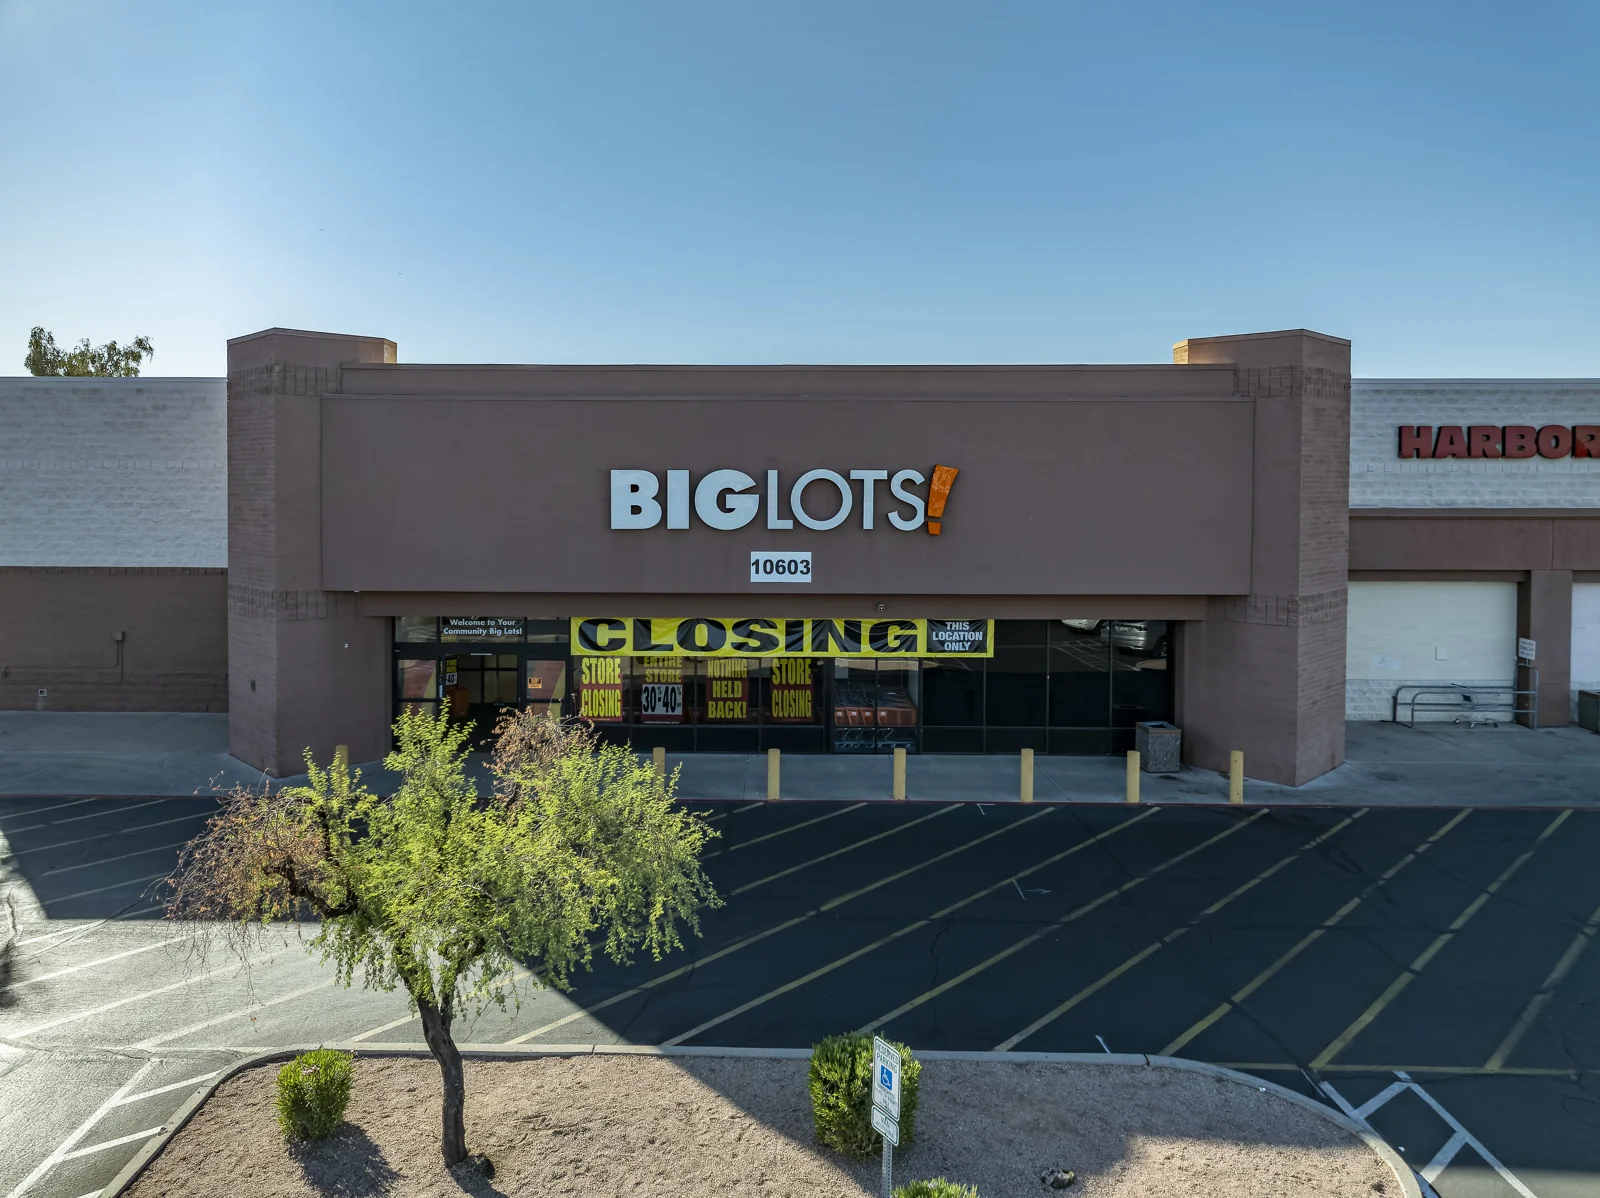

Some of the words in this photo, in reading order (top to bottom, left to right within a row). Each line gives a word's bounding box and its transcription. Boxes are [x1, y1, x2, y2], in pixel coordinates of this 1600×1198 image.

[1397, 425, 1600, 459] HARBOR
[751, 559, 811, 575] 10603
[443, 627, 487, 637] Community
[489, 627, 502, 636] Big
[503, 627, 523, 635] Lots!
[945, 621, 970, 630] THIS
[578, 618, 918, 652] CLOSING
[932, 631, 983, 641] LOCATION
[944, 641, 972, 651] ONLY
[581, 657, 621, 685] STORE
[643, 656, 683, 668] ENTIRE
[707, 658, 748, 678] NOTHING
[645, 669, 682, 683] STORE
[772, 658, 812, 685] STORE
[712, 680, 743, 698] HELD
[581, 689, 621, 717] CLOSING
[707, 701, 748, 719] BACK!
[772, 690, 812, 718] CLOSING
